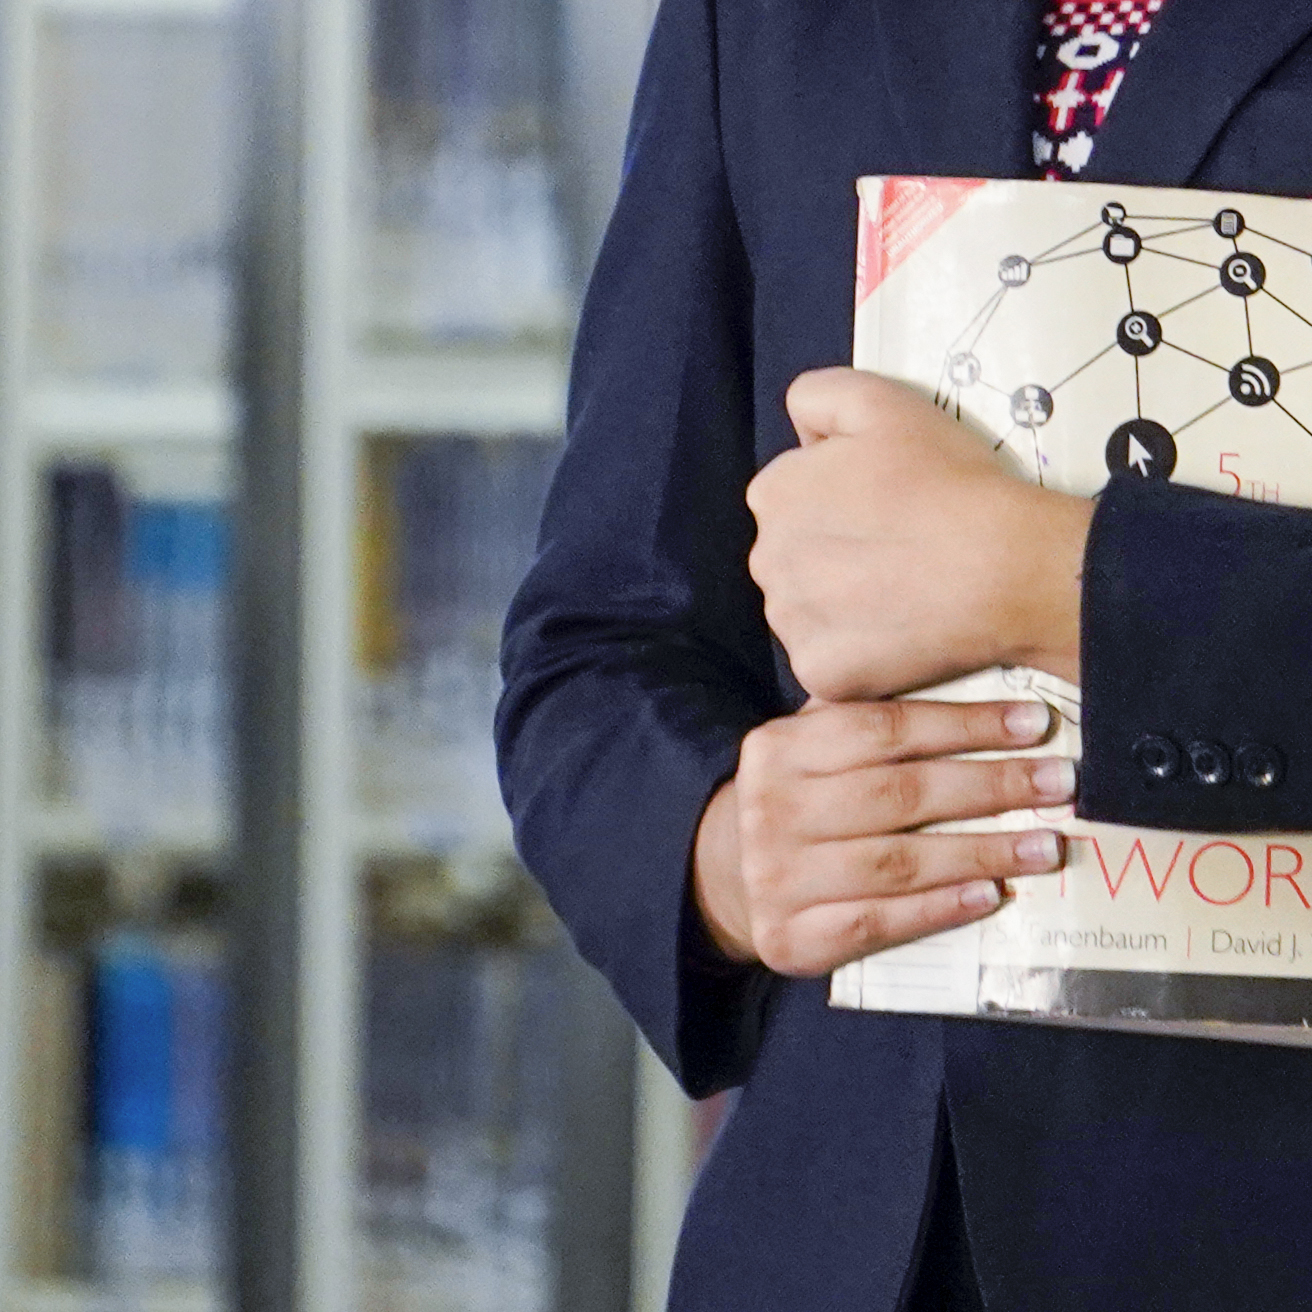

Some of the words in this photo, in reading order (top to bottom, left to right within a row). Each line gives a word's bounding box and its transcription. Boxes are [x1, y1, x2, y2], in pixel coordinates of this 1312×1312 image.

[1219, 451, 1280, 503] 5TH
[1211, 929, 1282, 957] David
[1290, 933, 1303, 964] J.
